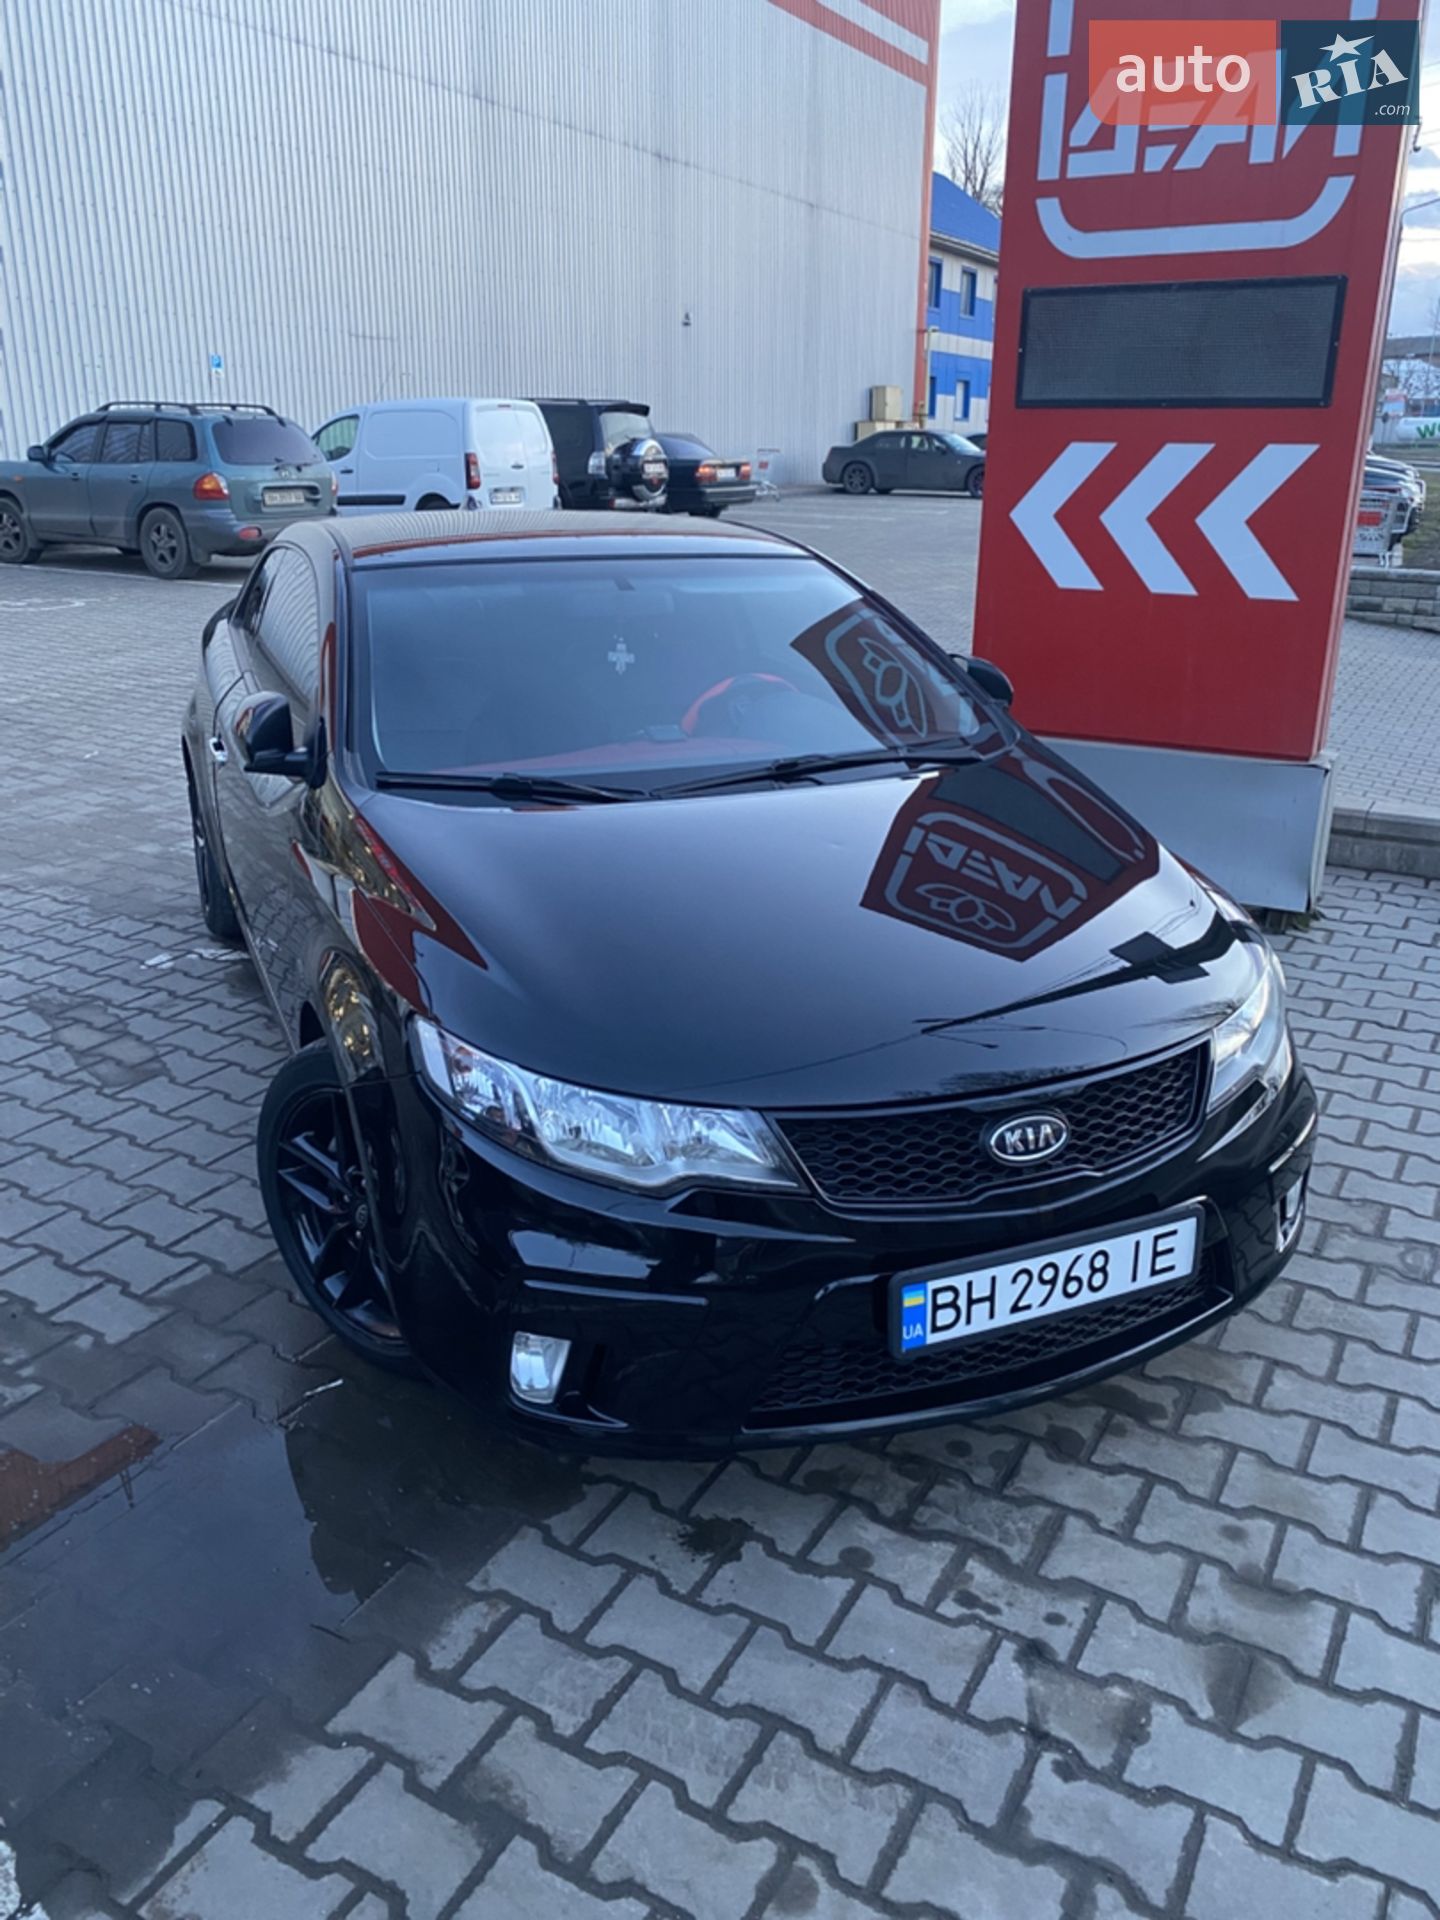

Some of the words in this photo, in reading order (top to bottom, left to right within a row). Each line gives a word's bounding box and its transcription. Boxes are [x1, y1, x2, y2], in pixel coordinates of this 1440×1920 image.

[1416, 421, 1440, 439] W
[1004, 1123, 1057, 1154] KIA
[930, 1275, 998, 1335] BH
[1009, 1249, 1110, 1316] 2968
[1130, 1229, 1179, 1283] IE
[902, 1323, 924, 1341] UA
